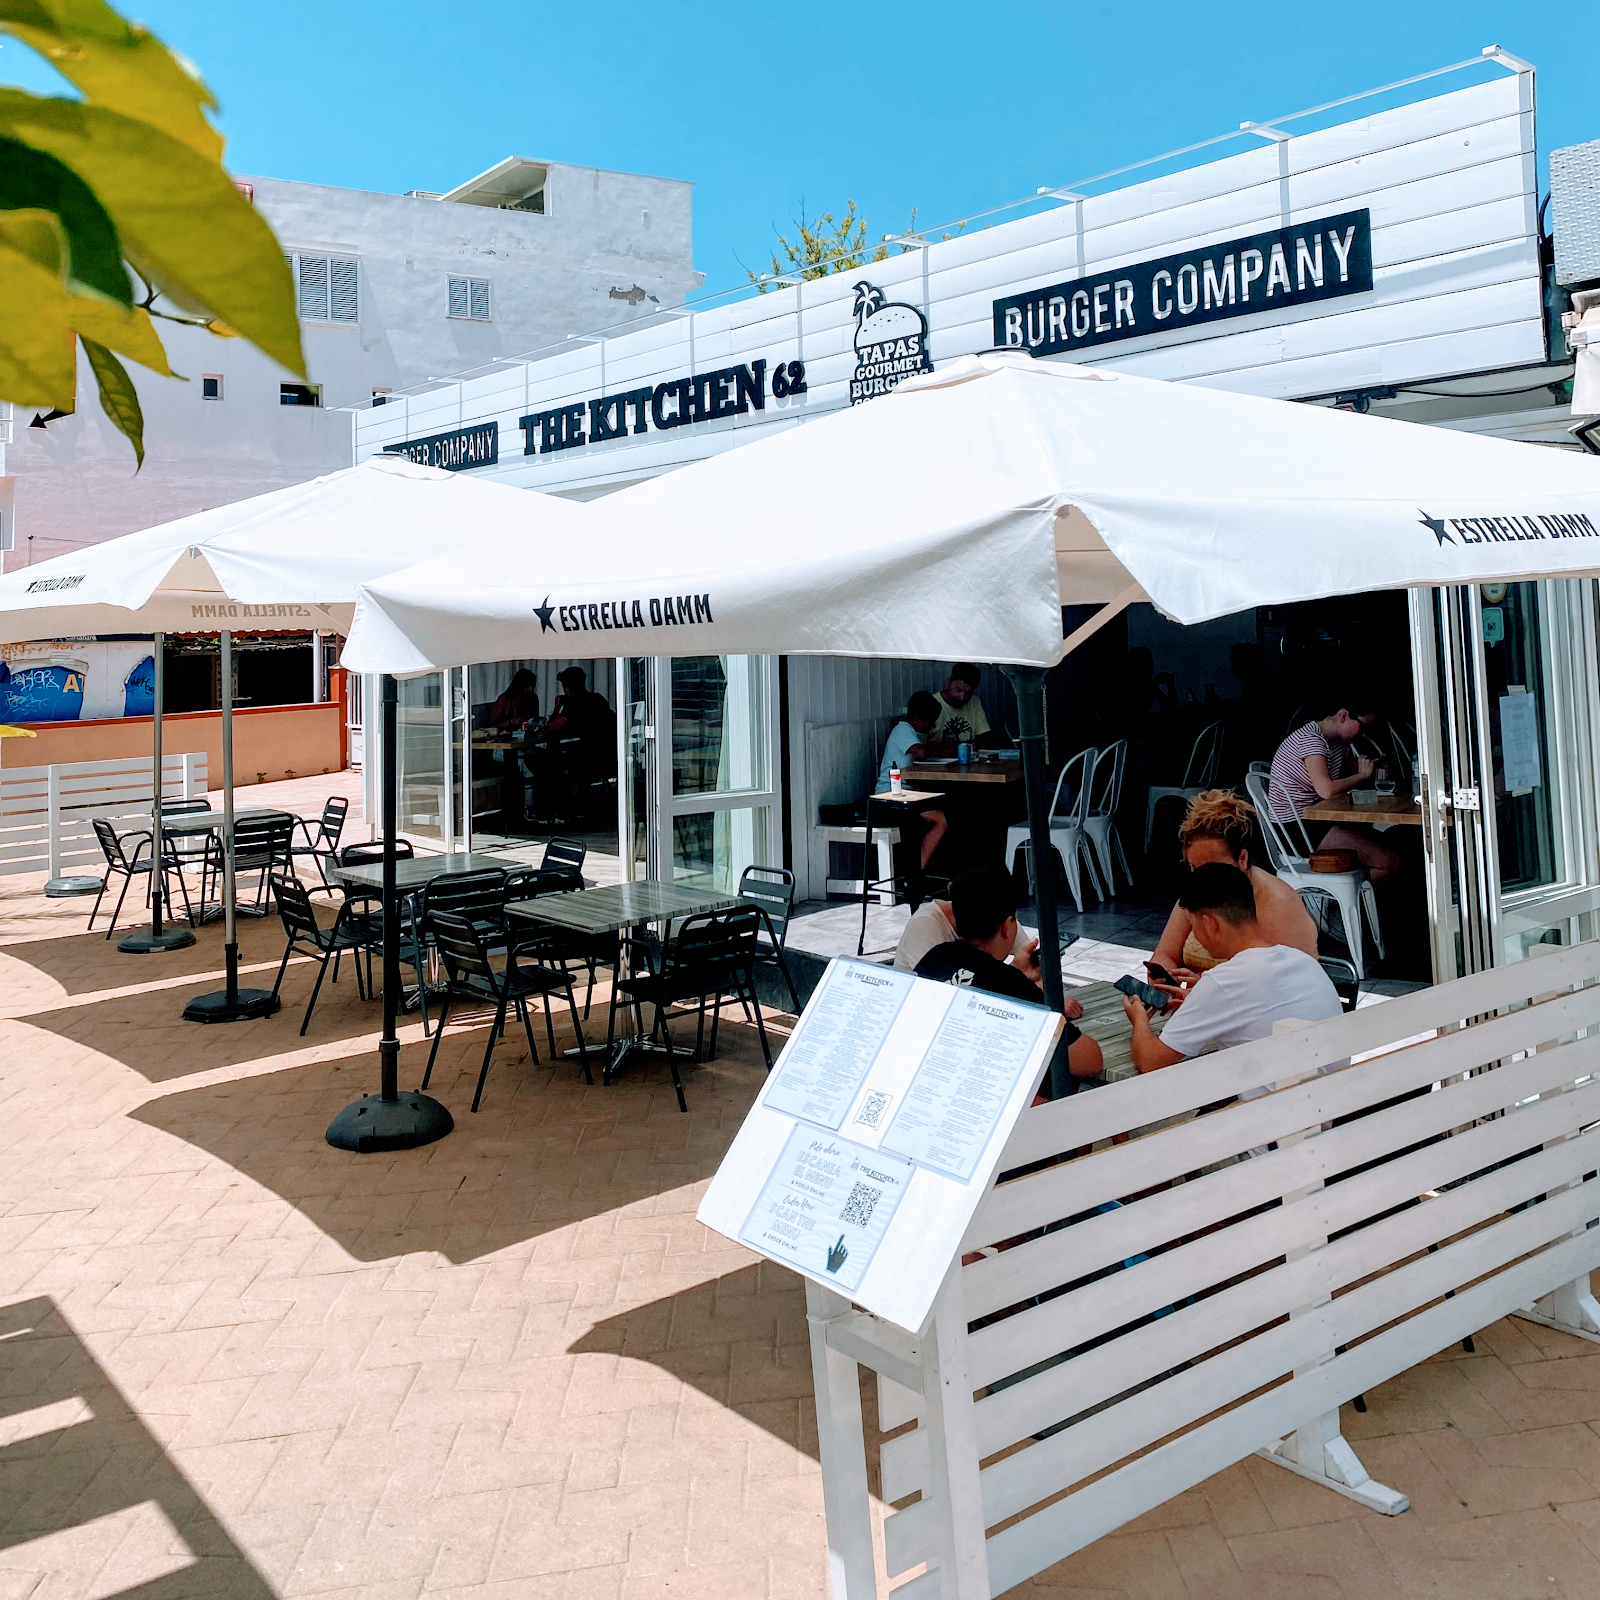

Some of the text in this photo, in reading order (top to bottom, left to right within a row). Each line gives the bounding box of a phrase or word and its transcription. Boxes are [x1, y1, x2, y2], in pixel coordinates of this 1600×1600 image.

[1004, 225, 1357, 349] BURGER COMPANY
[859, 336, 920, 365] TAPAS
[856, 354, 924, 380] GOURMET
[851, 367, 929, 398] BURG
[518, 358, 808, 456] THE KITCHEN 62
[434, 429, 494, 468] COMPANY
[1448, 513, 1600, 544] ESTRELLA DAMM
[559, 593, 714, 632] ESTRELLA DAMM
[977, 1003, 991, 1012] THE
[990, 1007, 1020, 1020] KITCHEN
[793, 1164, 805, 1179] EL
[796, 1150, 841, 1178] ESCANEA
[859, 1165, 870, 1174] THE
[869, 1169, 896, 1184] KITCHEN
[769, 1202, 817, 1232] SCAN THE
[771, 1219, 801, 1241] MENU
